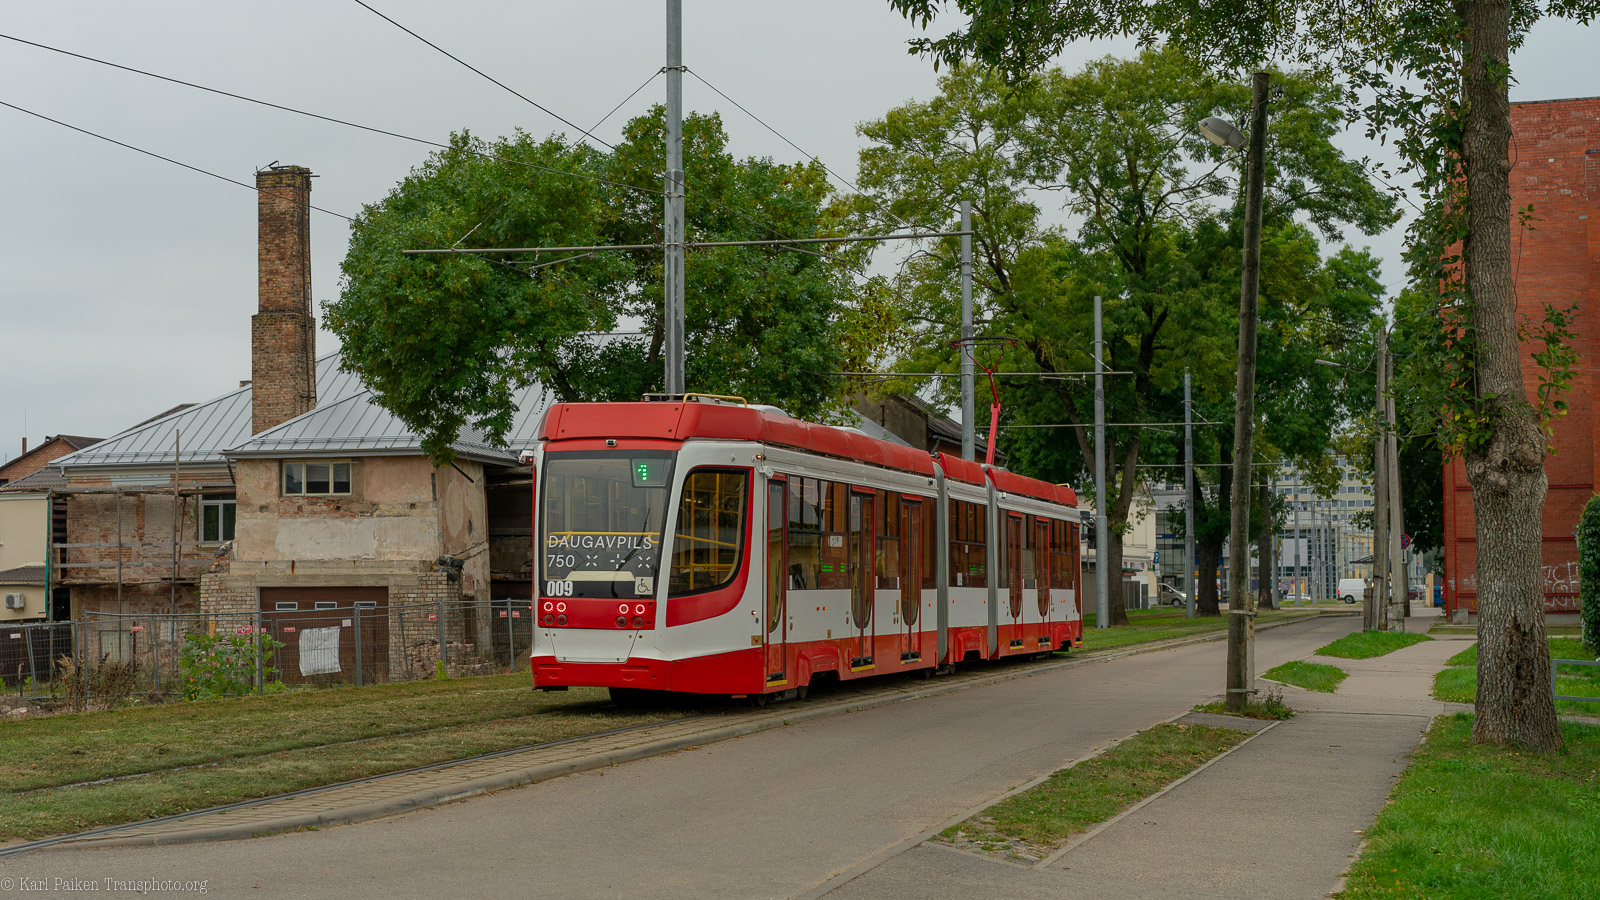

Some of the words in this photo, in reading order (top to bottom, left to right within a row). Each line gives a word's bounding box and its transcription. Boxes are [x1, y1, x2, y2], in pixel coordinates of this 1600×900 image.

[548, 535, 652, 550] DAUGAVPILS
[547, 554, 575, 568] 750
[546, 580, 574, 597] 009
